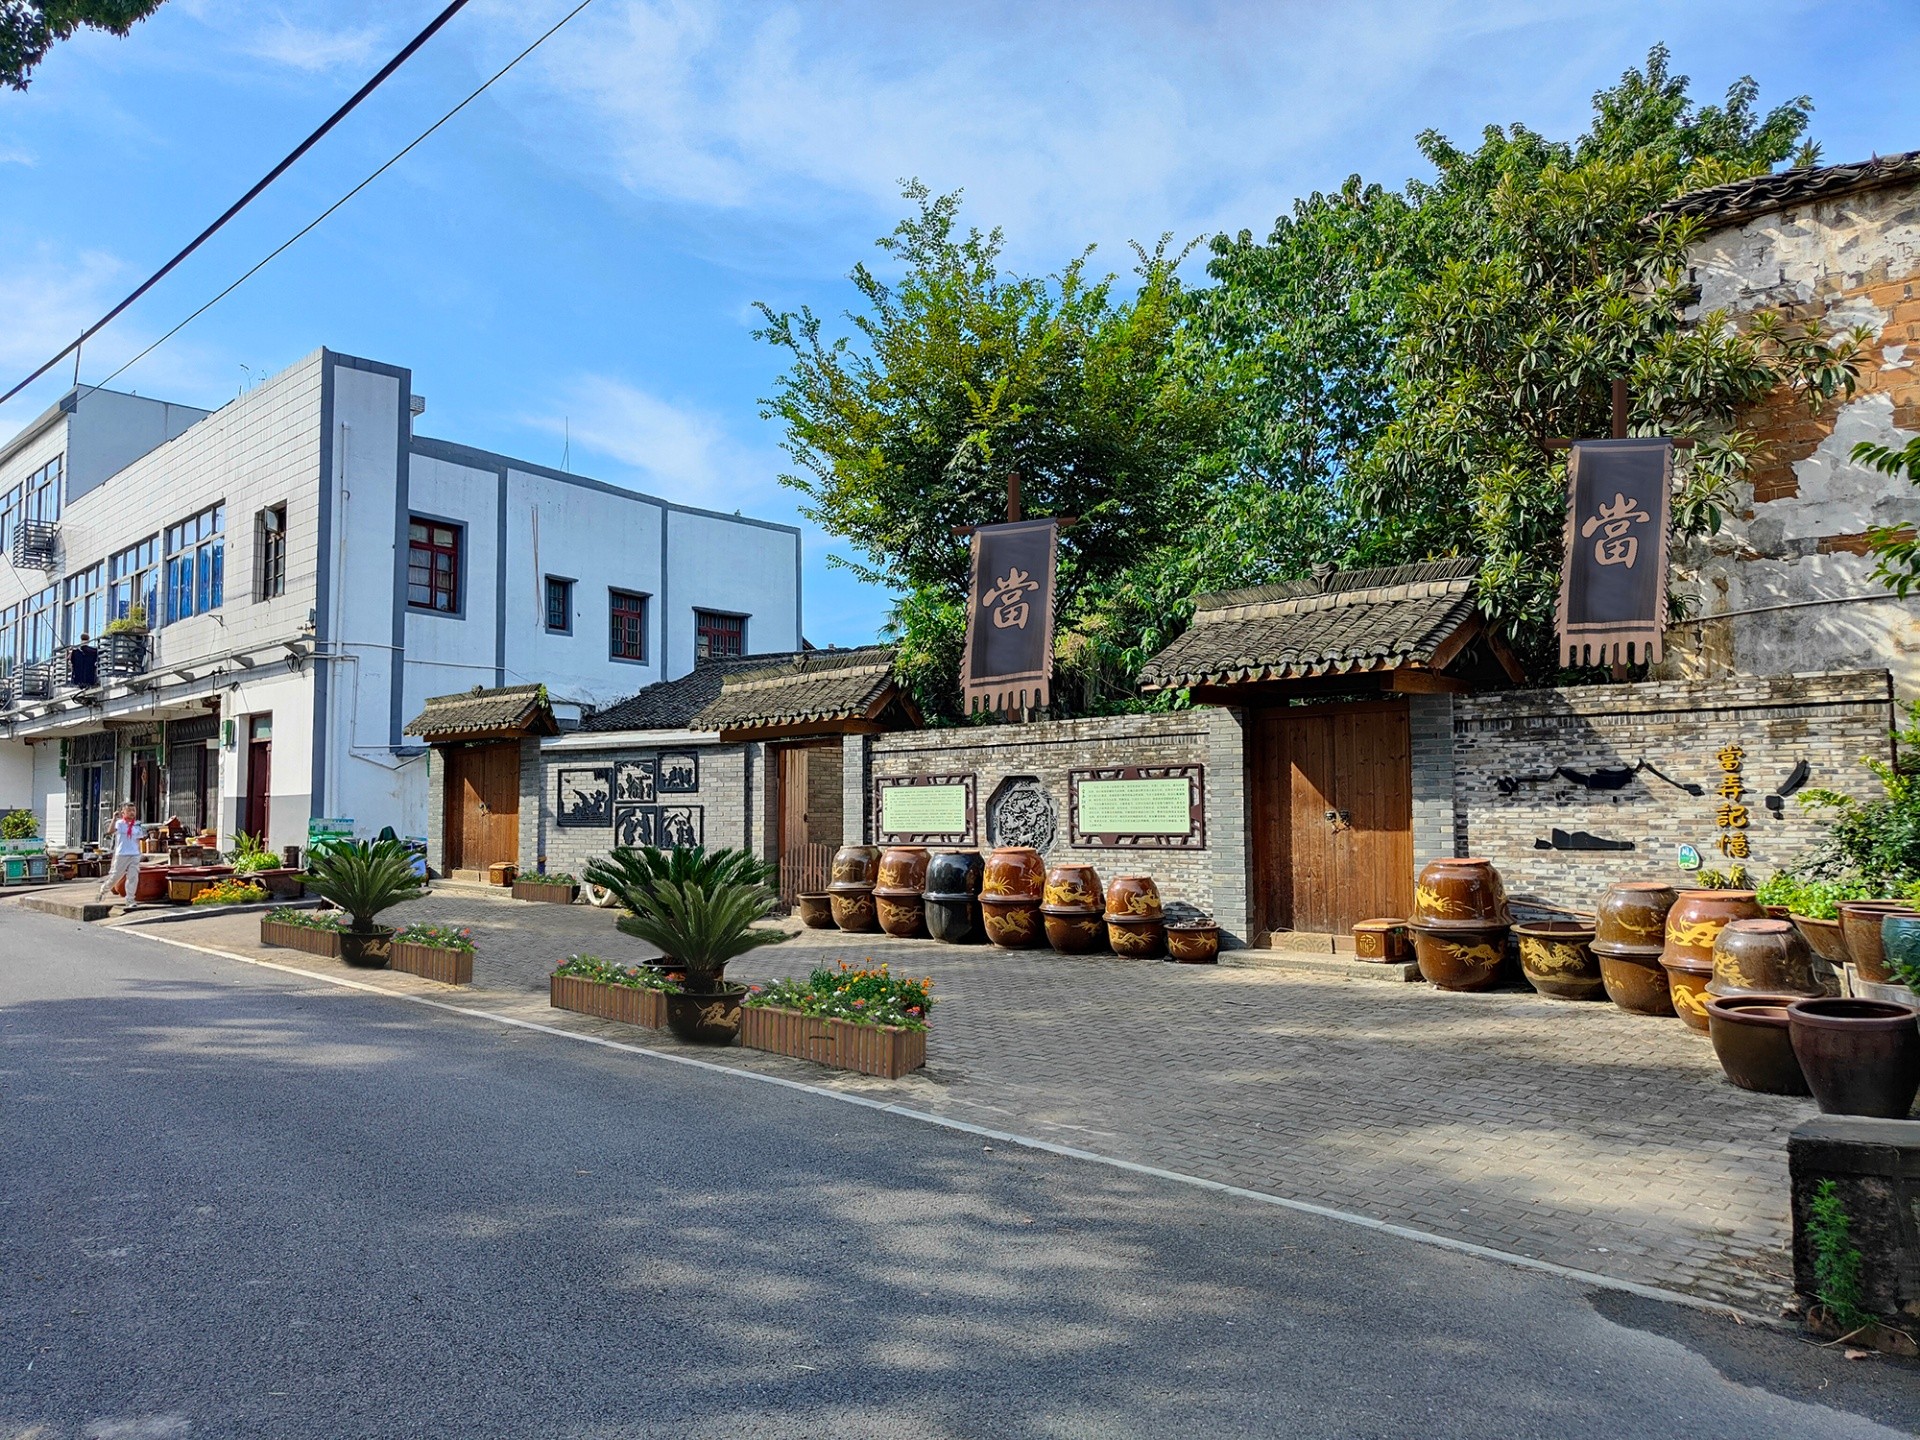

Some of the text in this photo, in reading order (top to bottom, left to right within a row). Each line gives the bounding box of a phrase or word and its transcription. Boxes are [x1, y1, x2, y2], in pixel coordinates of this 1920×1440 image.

[1582, 493, 1650, 569] 當
[982, 567, 1039, 630] 當
[1716, 745, 1748, 857] 當弄記憶
